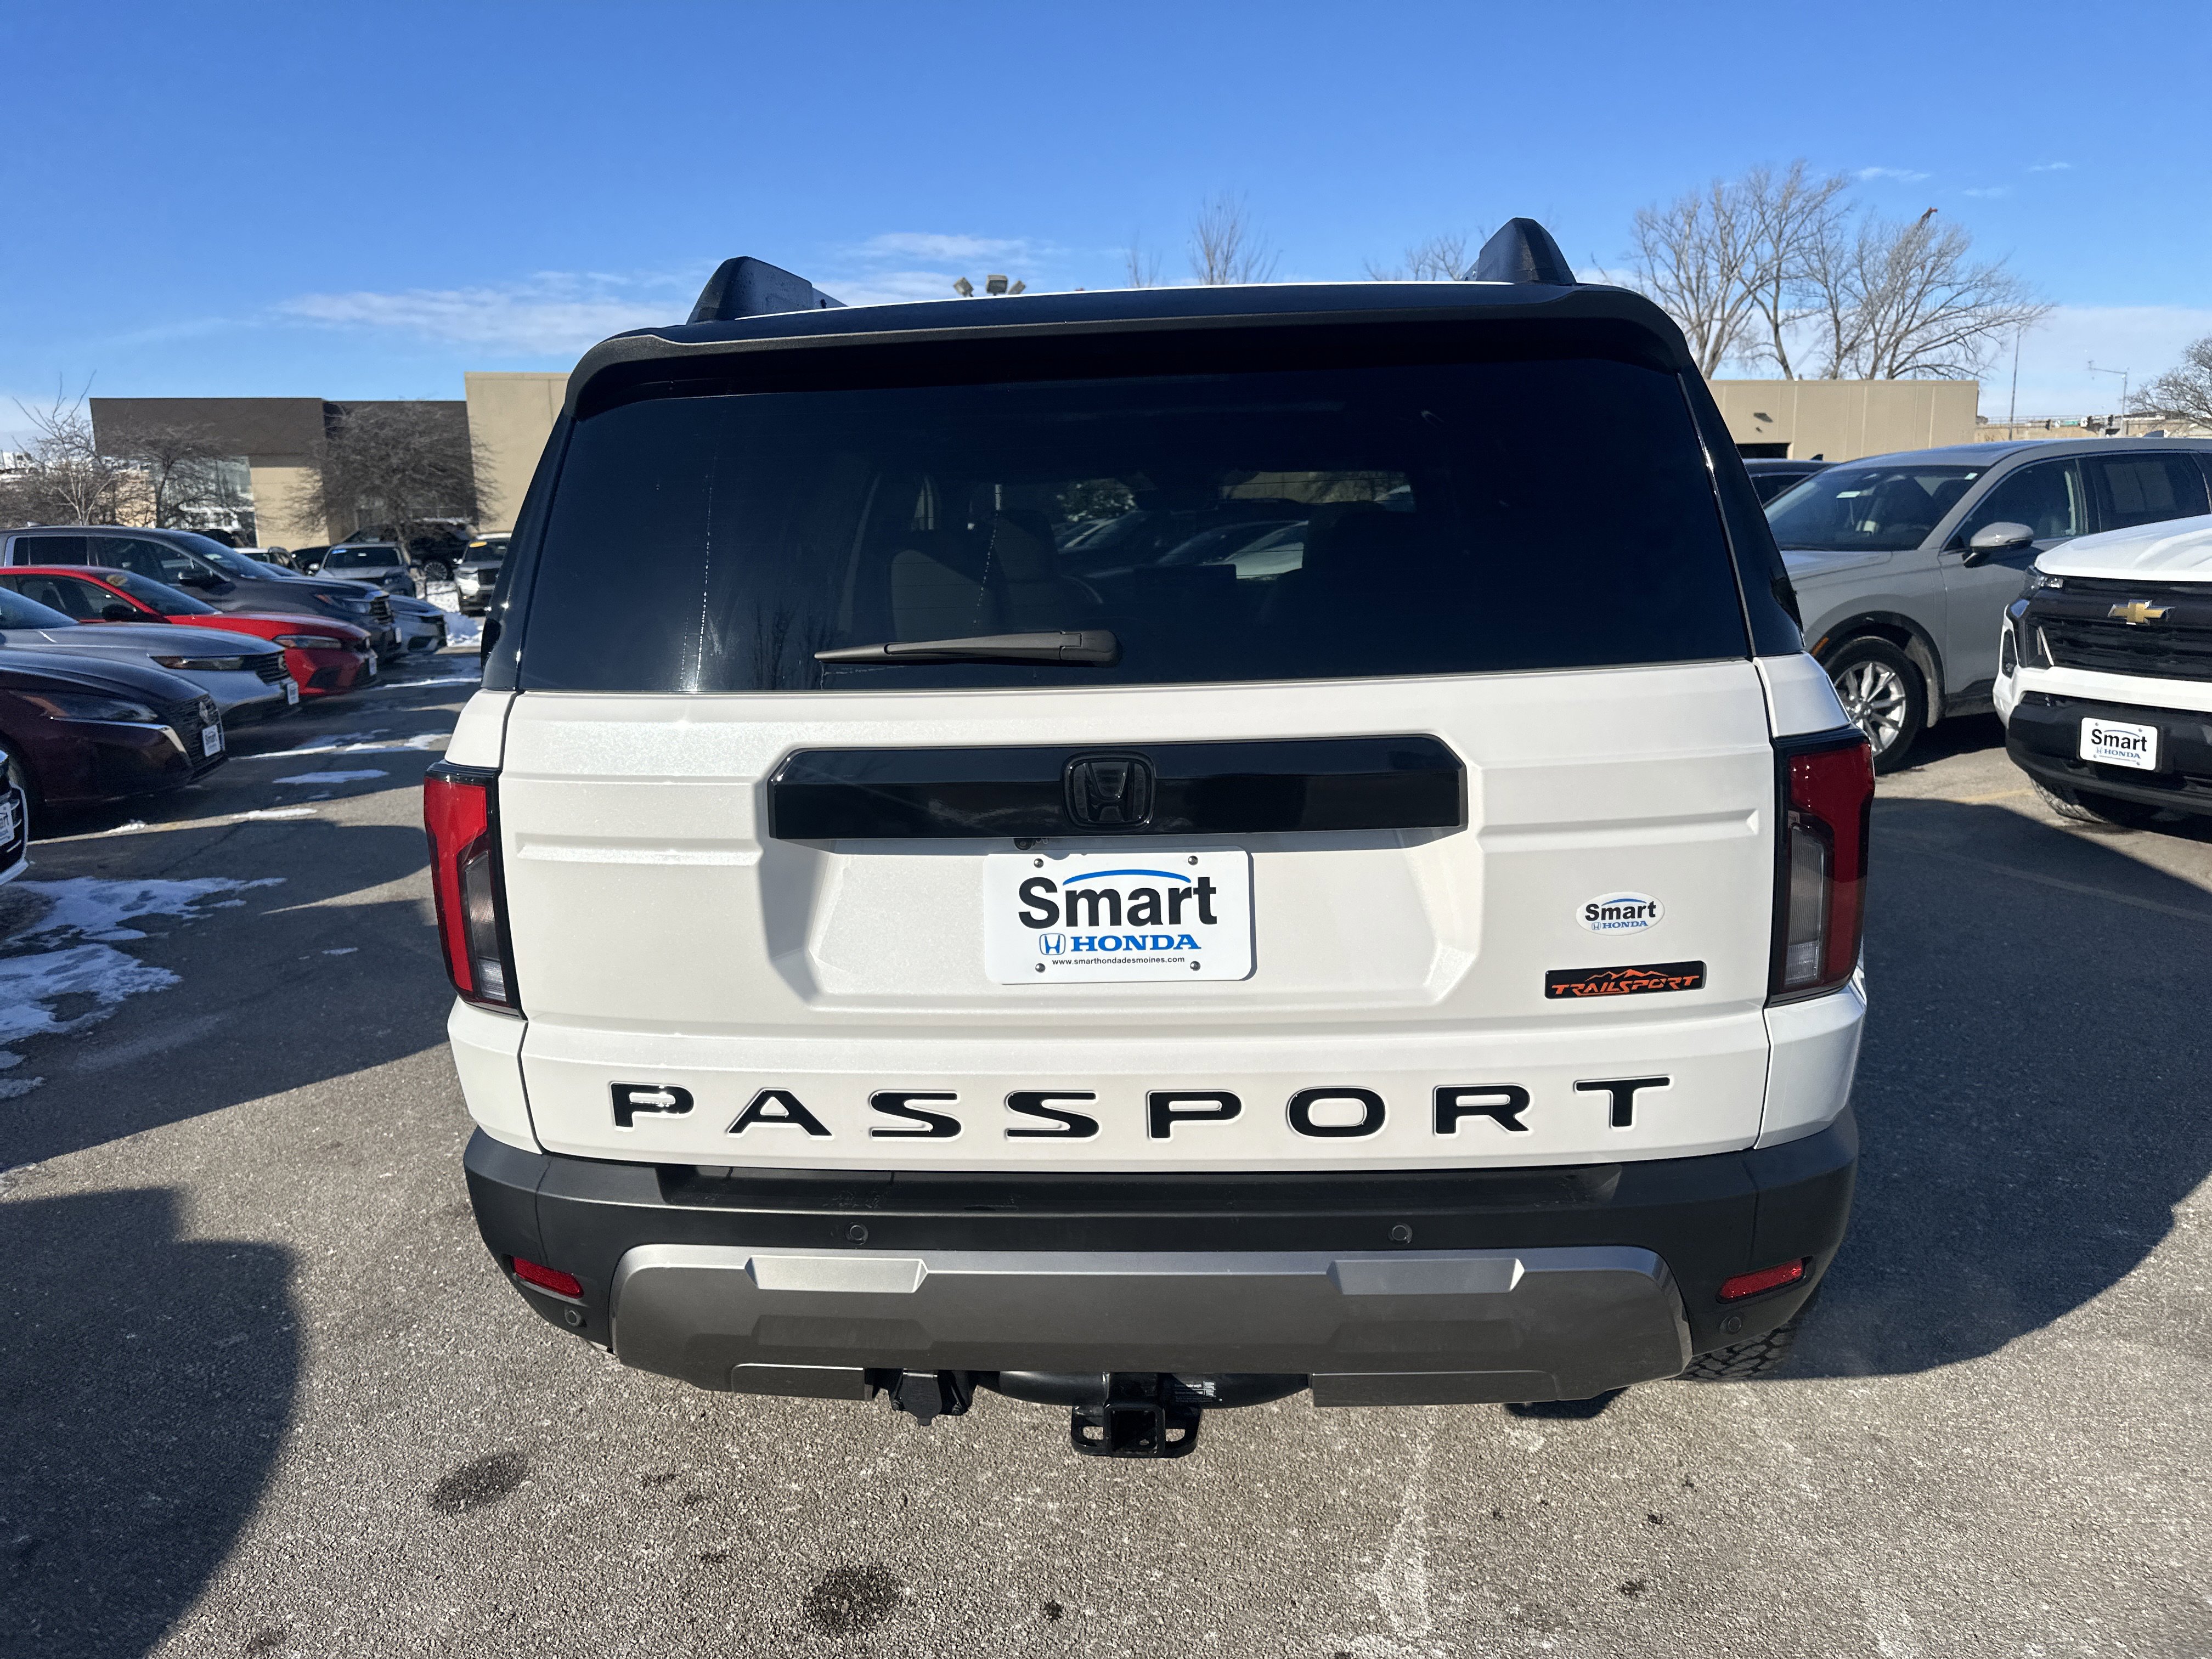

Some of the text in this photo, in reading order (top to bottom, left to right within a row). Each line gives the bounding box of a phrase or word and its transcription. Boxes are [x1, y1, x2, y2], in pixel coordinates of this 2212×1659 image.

[2091, 729, 2147, 752] Smart
[2104, 748, 2141, 759] HONDA
[1019, 877, 1217, 929] Smart
[1585, 901, 1656, 921] Smart
[1601, 921, 1649, 929] HONDA
[1070, 934, 1201, 952] HONDA
[1052, 956, 1185, 965] www.smarthondadesmoines.com
[1551, 975, 1700, 996] TRAILSPORT
[611, 1076, 1671, 1138] PASSPORT
